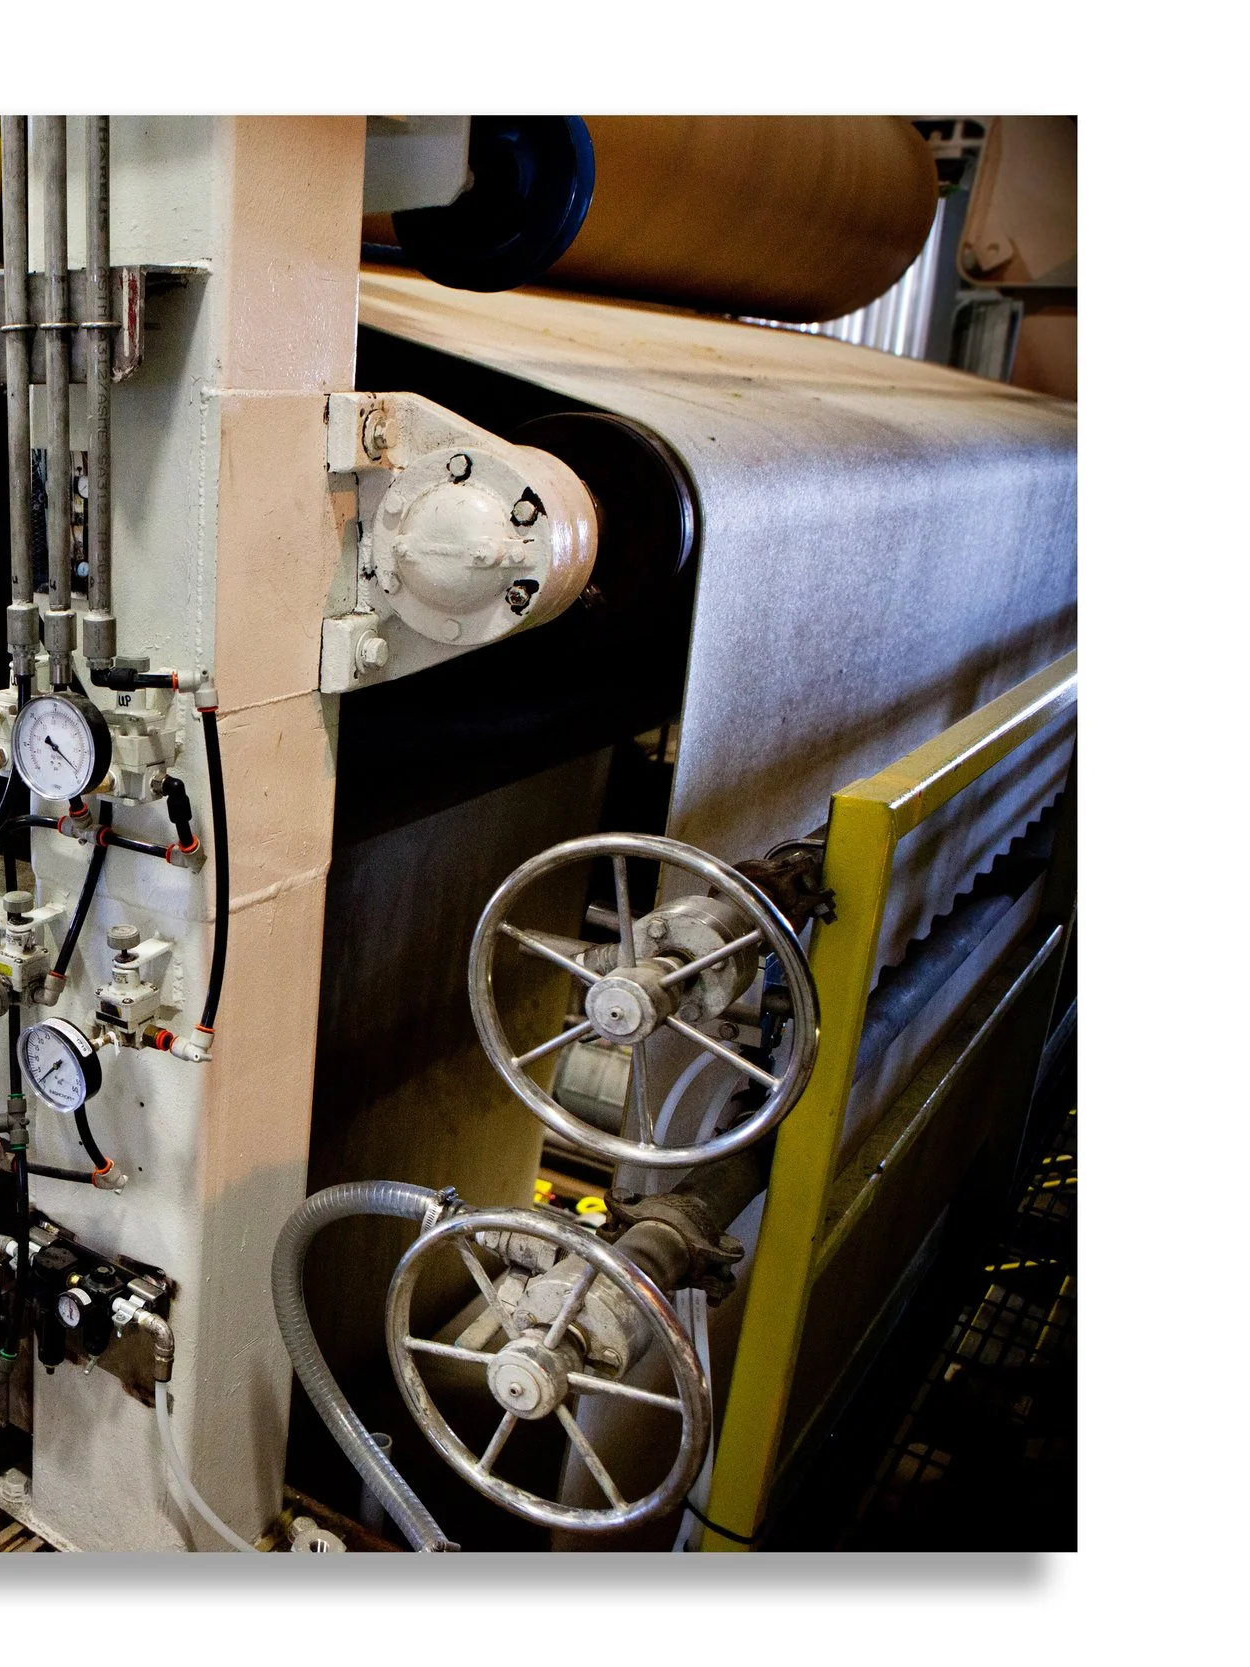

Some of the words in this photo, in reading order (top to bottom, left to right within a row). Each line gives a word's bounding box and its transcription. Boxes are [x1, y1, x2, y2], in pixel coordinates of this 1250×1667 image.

[97, 267, 108, 317] ASTM
[97, 455, 108, 515] SA312
[118, 694, 132, 708] UP
